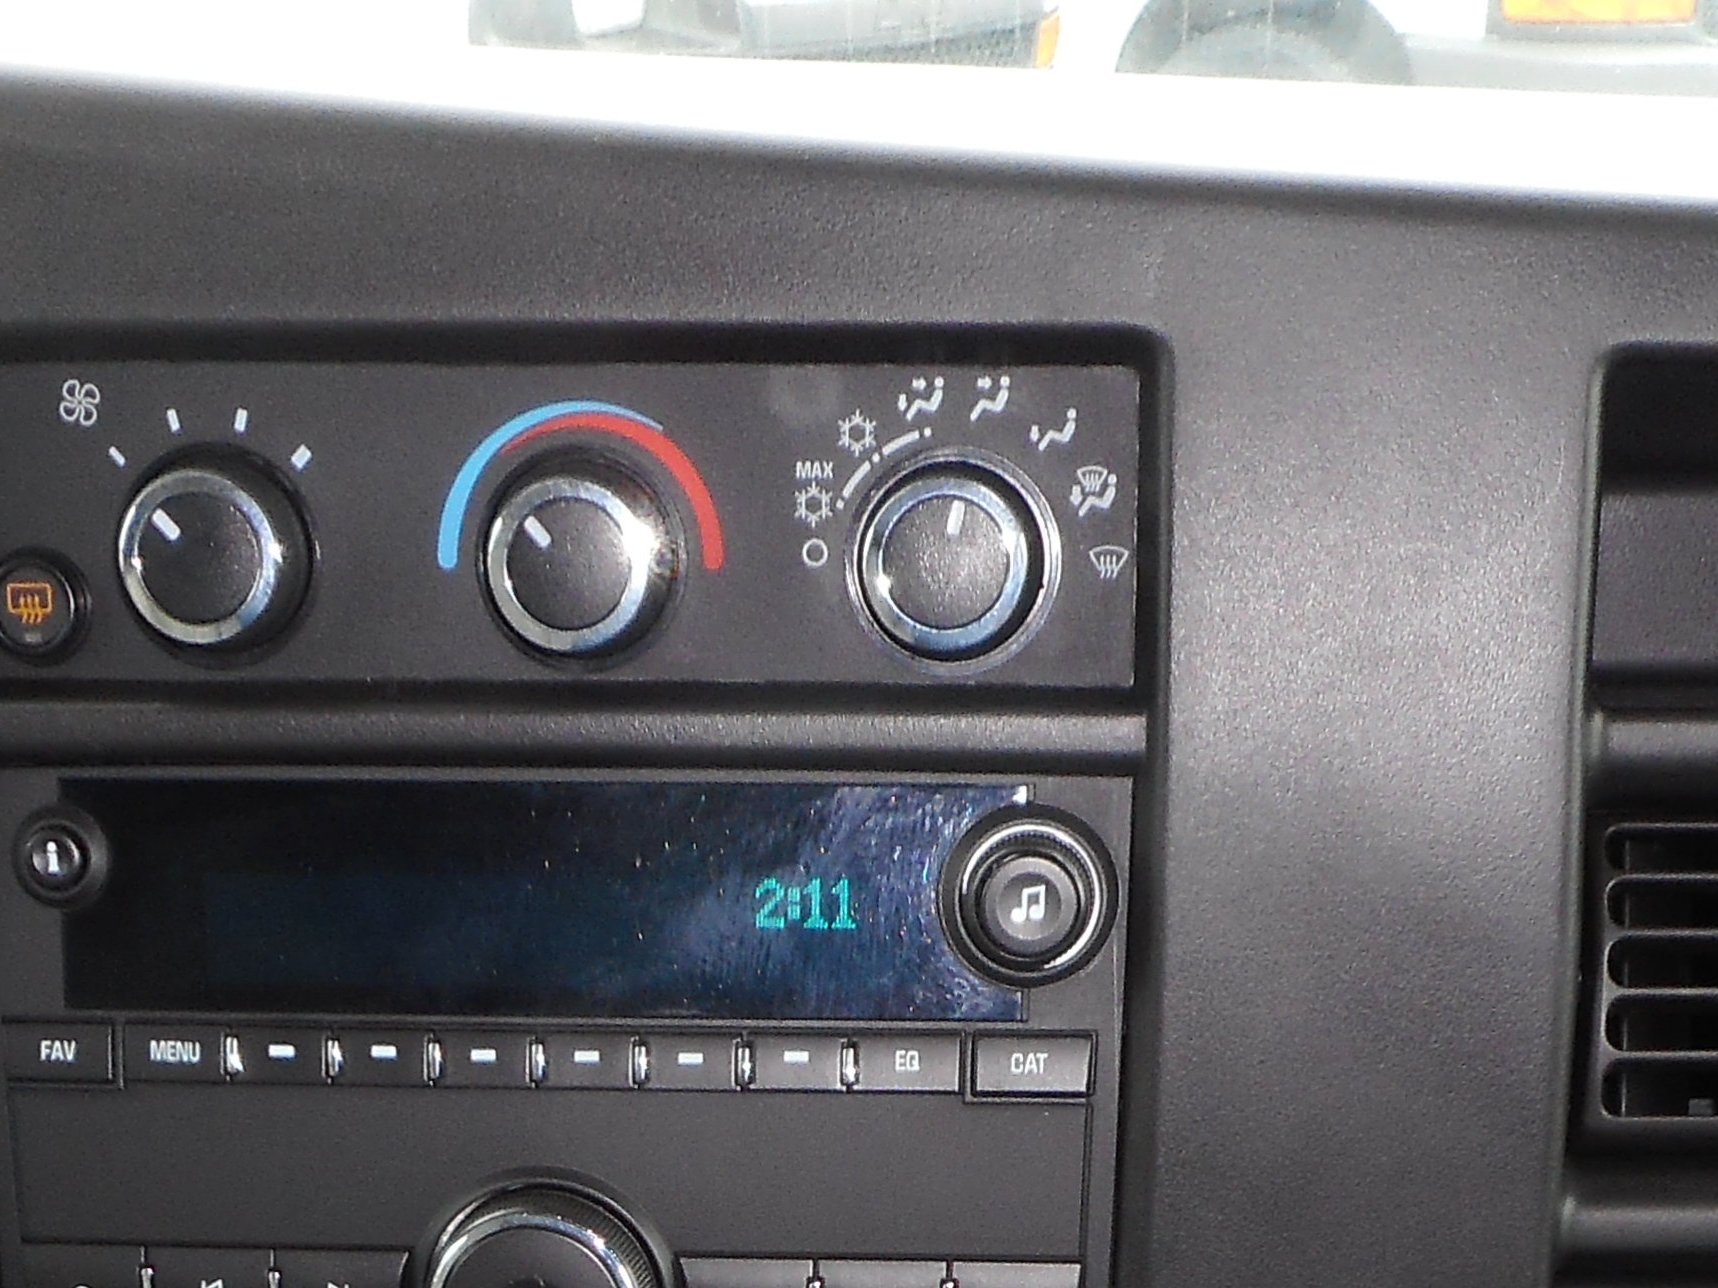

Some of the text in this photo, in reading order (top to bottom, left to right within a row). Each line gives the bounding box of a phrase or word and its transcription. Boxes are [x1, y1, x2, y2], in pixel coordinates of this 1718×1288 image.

[795, 460, 834, 479] MAX
[754, 876, 858, 930] 2:11
[39, 1039, 78, 1062] FAV
[149, 1039, 201, 1062] MENU
[894, 1049, 920, 1073] EQ
[1010, 1052, 1049, 1075] CAT
